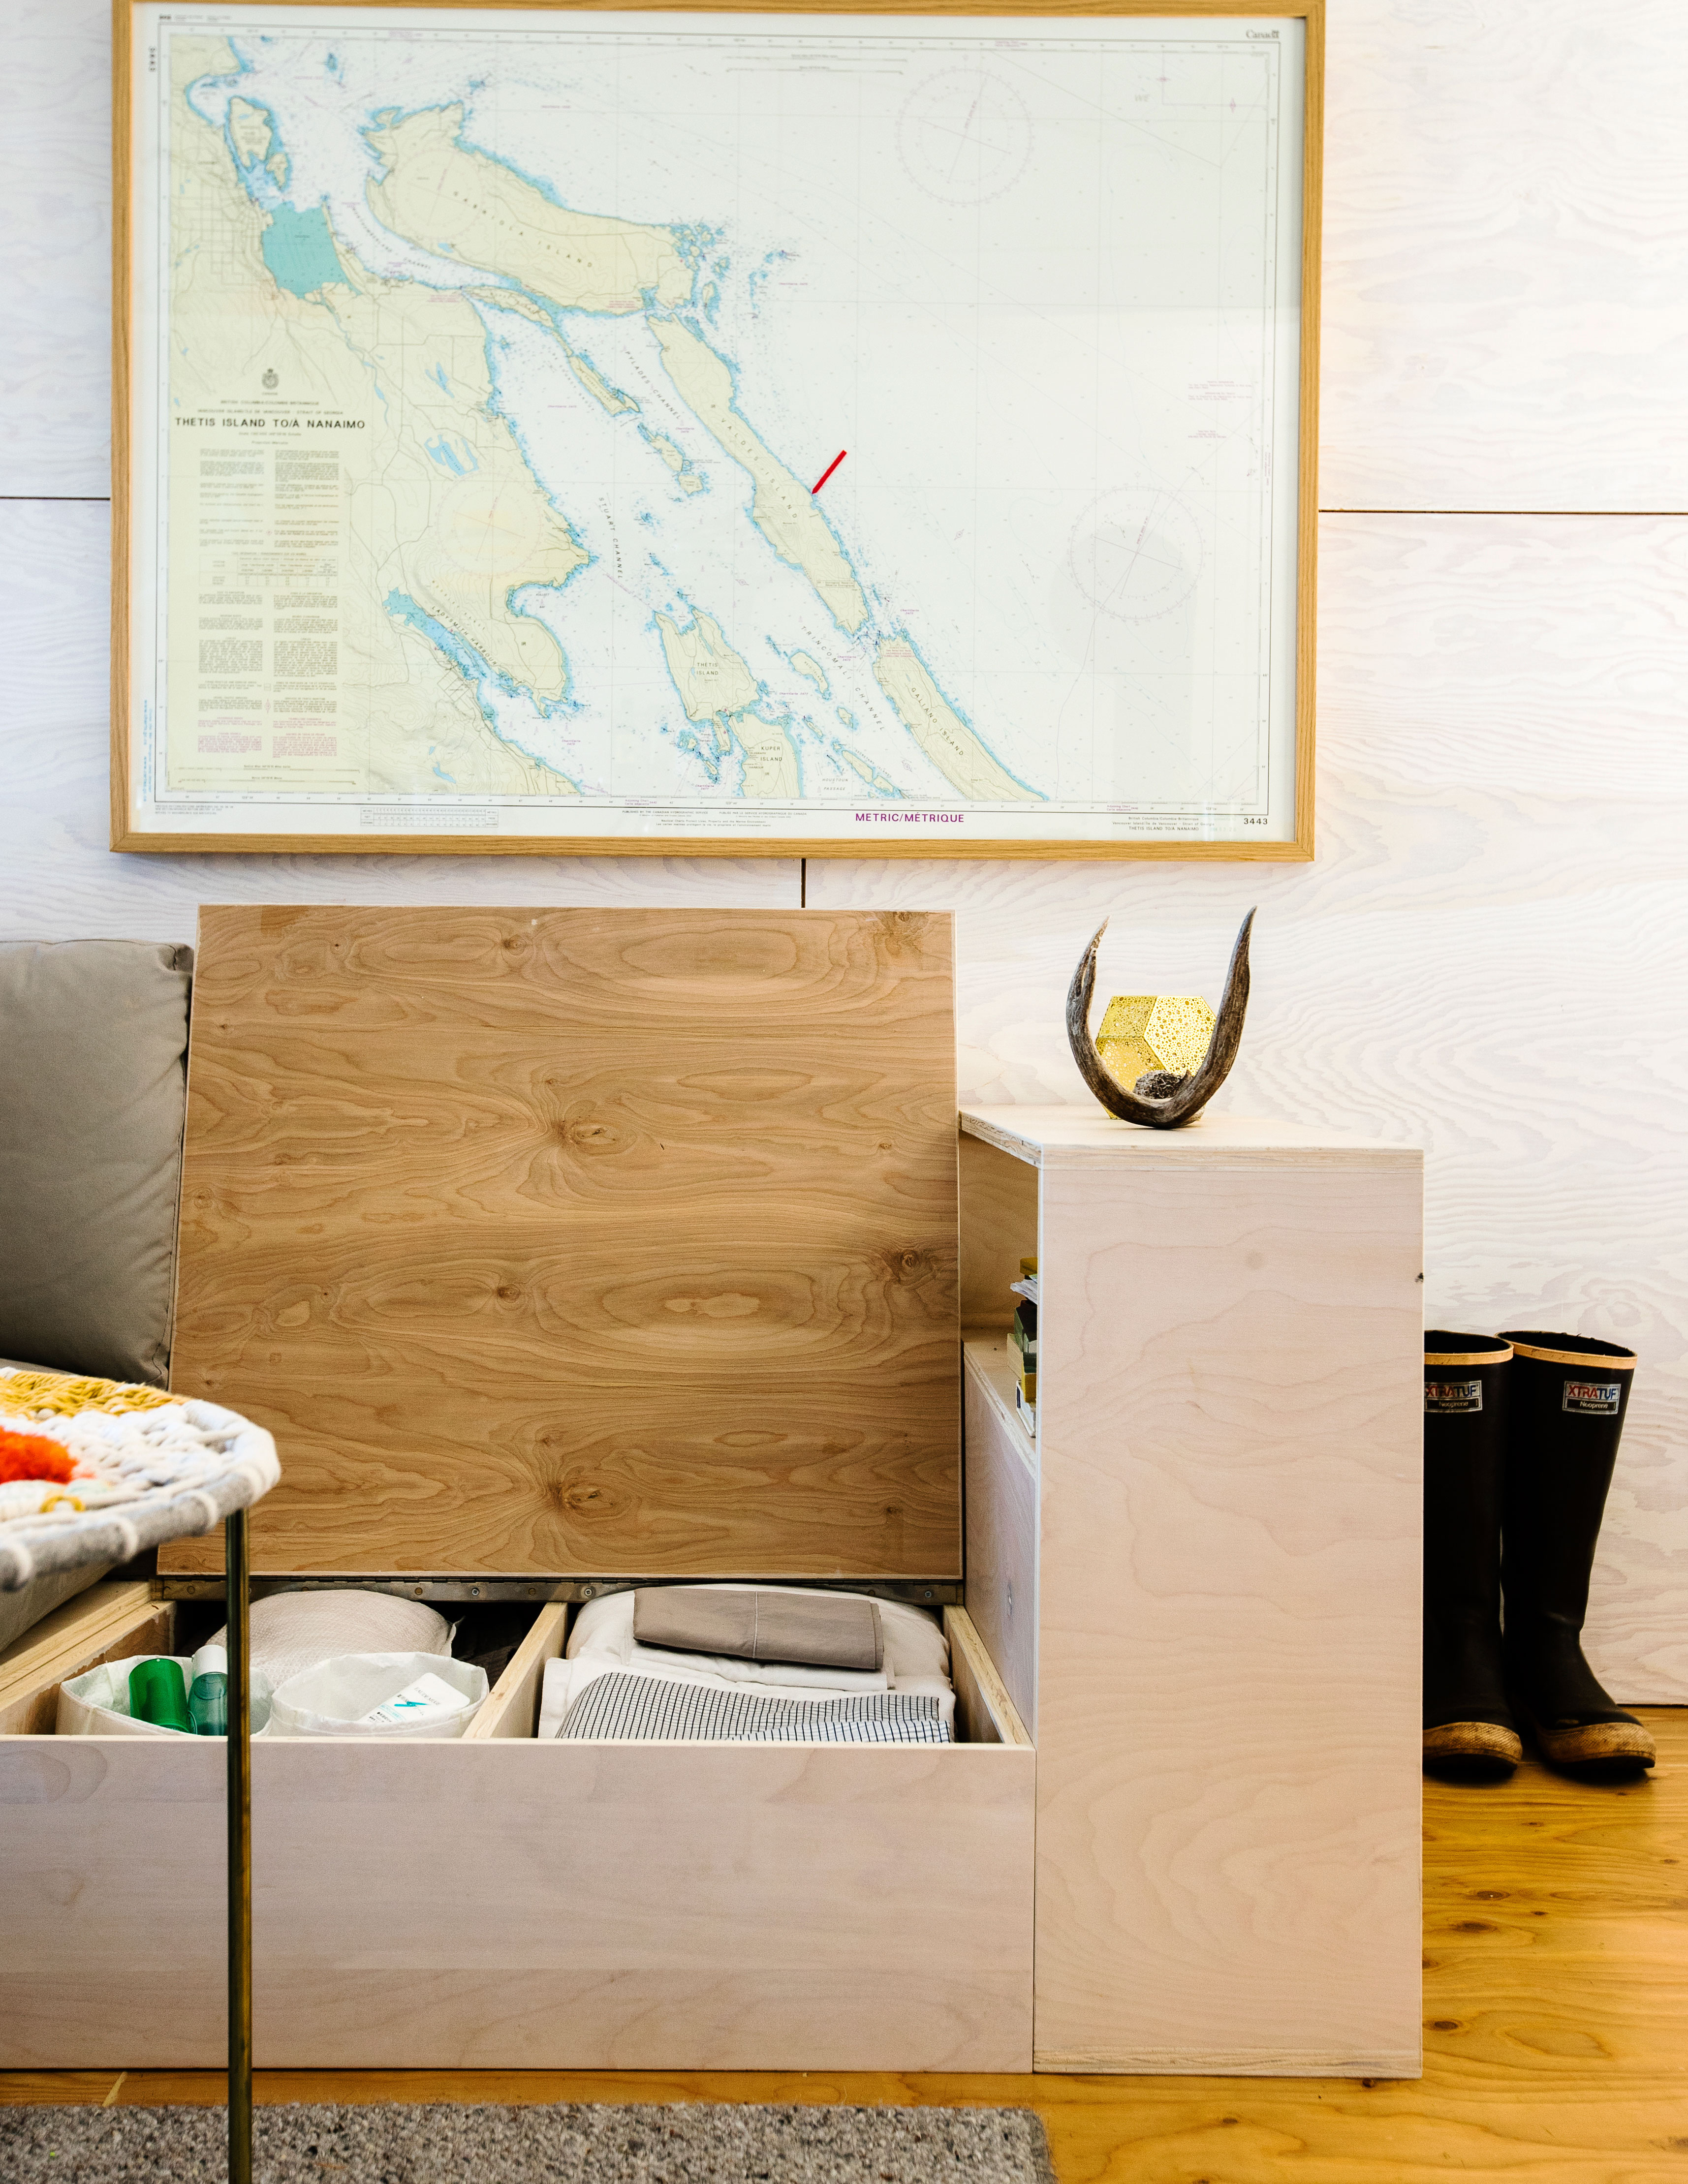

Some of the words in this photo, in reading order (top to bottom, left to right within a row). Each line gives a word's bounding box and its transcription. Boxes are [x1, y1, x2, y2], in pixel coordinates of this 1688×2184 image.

[538, 241, 593, 268] ISLAND
[625, 351, 650, 385] PYLADES
[653, 389, 681, 420] CHANNEL
[176, 417, 216, 427] THETIS
[223, 419, 265, 428] ISLAND
[273, 417, 299, 428] TO/À
[307, 420, 366, 429] NANAIMO
[720, 418, 758, 461] VALDES
[763, 470, 797, 519] ISLAND
[598, 497, 616, 531] STUART
[613, 538, 623, 579] CHANNEL
[432, 606, 469, 635] LADYSMITH
[470, 638, 497, 665] HARBOUR
[801, 626, 851, 679] TRINCOMALI
[854, 687, 885, 731] CHANNEL
[911, 687, 938, 724] GALIANO
[939, 728, 964, 756] ISLAND
[855, 812, 965, 823] METRIC/MÉTRIQUE
[1425, 1384, 1476, 1397] XTRATUF
[1568, 1385, 1617, 1400] XTRATUF
